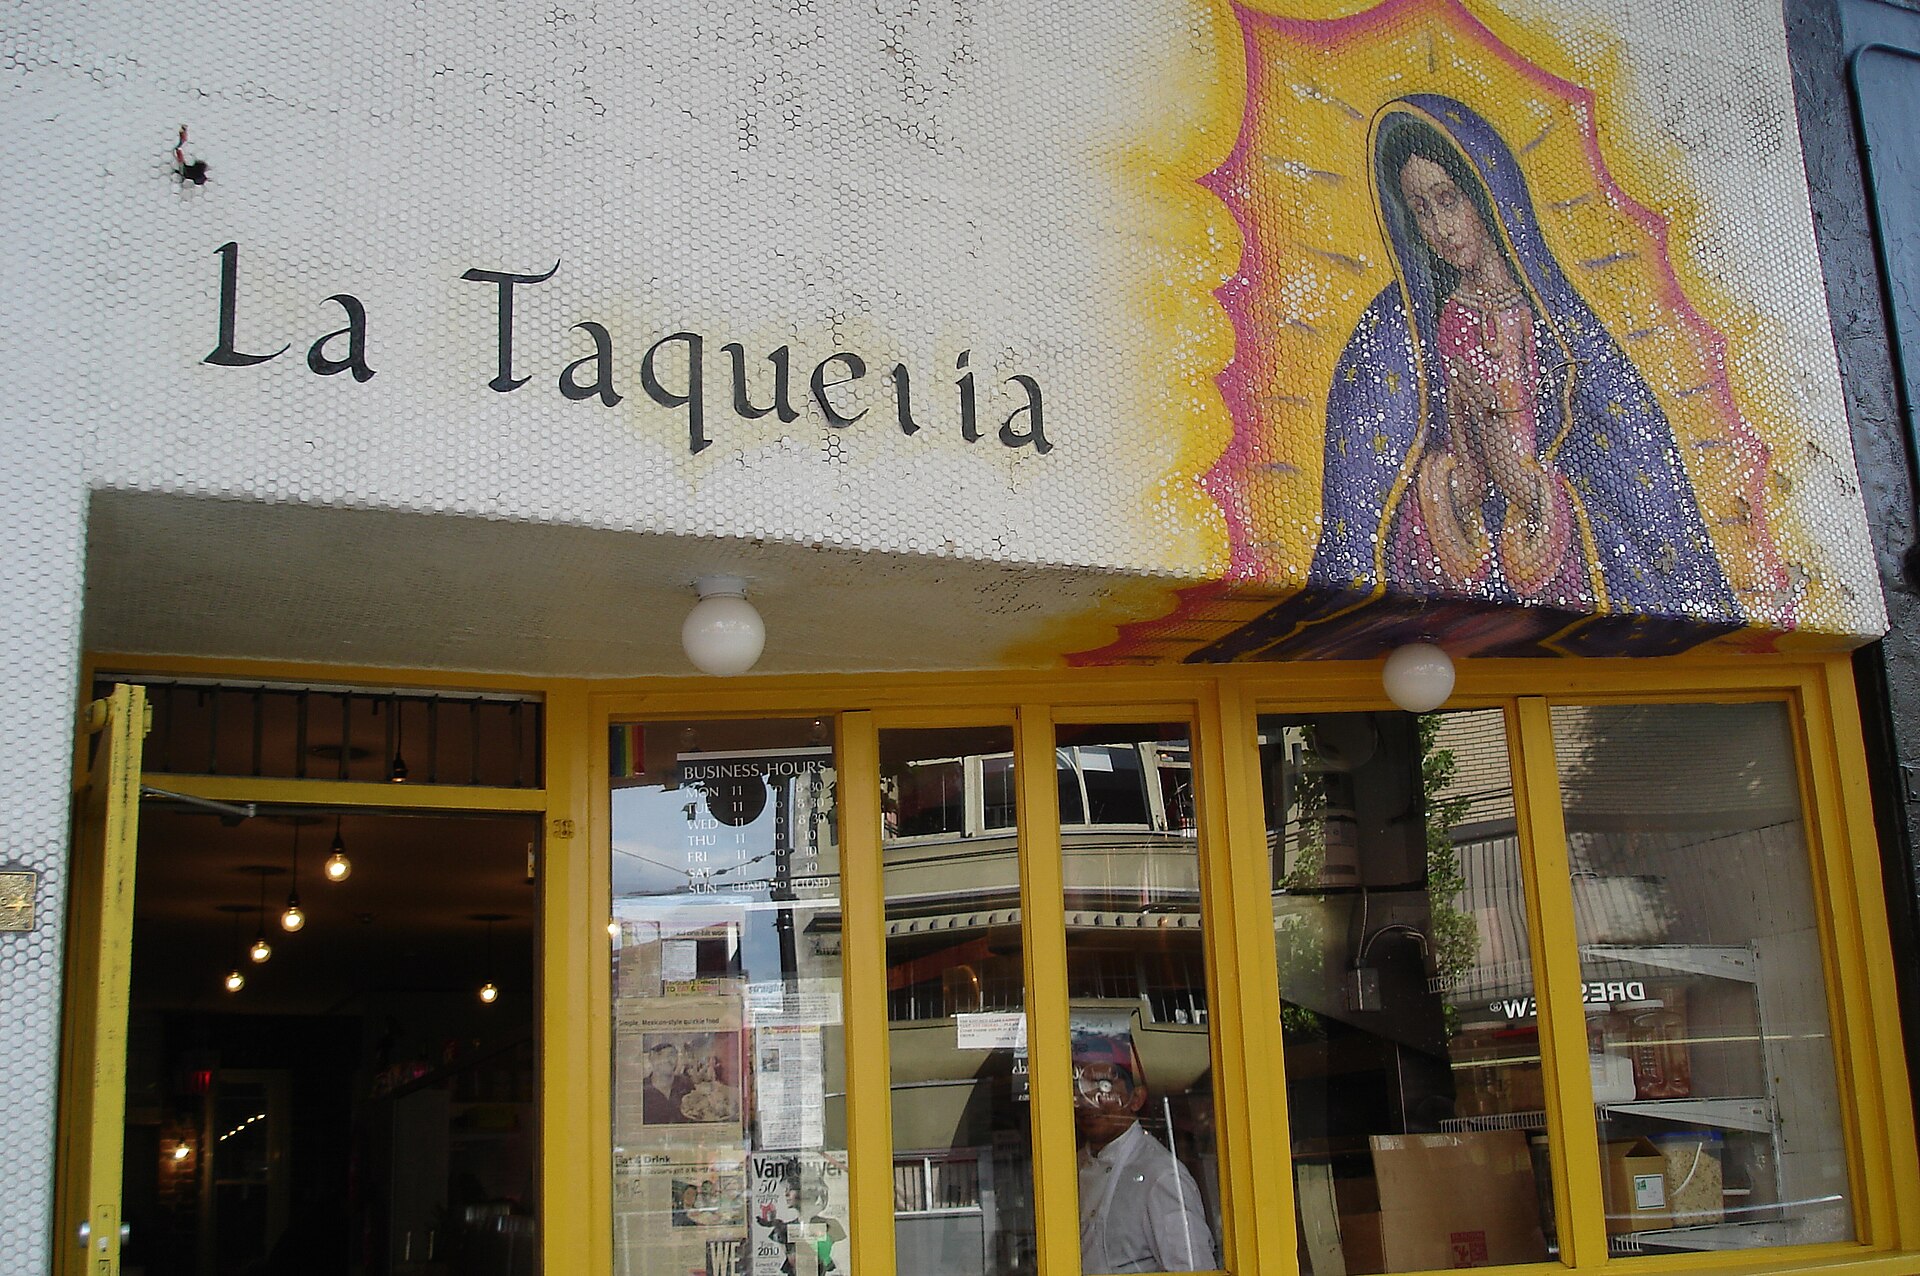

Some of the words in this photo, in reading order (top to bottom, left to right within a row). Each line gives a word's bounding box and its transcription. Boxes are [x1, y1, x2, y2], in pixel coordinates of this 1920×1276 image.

[203, 241, 377, 383] La
[459, 257, 1054, 456] Taqueria
[684, 763, 760, 780] BUSINESS
[767, 760, 826, 776] HOURS
[686, 786, 719, 798] MON
[687, 802, 712, 814] TUE
[687, 818, 719, 830] WED
[687, 834, 716, 846] THU
[687, 851, 707, 862] FRI
[688, 867, 711, 879] SAT
[688, 883, 717, 895] SUN
[796, 877, 831, 889] CLOSED
[643, 1155, 671, 1164] Drink
[753, 1158, 846, 1180] Vancover
[758, 1180, 777, 1194] 50
[757, 1246, 780, 1257] 2010
